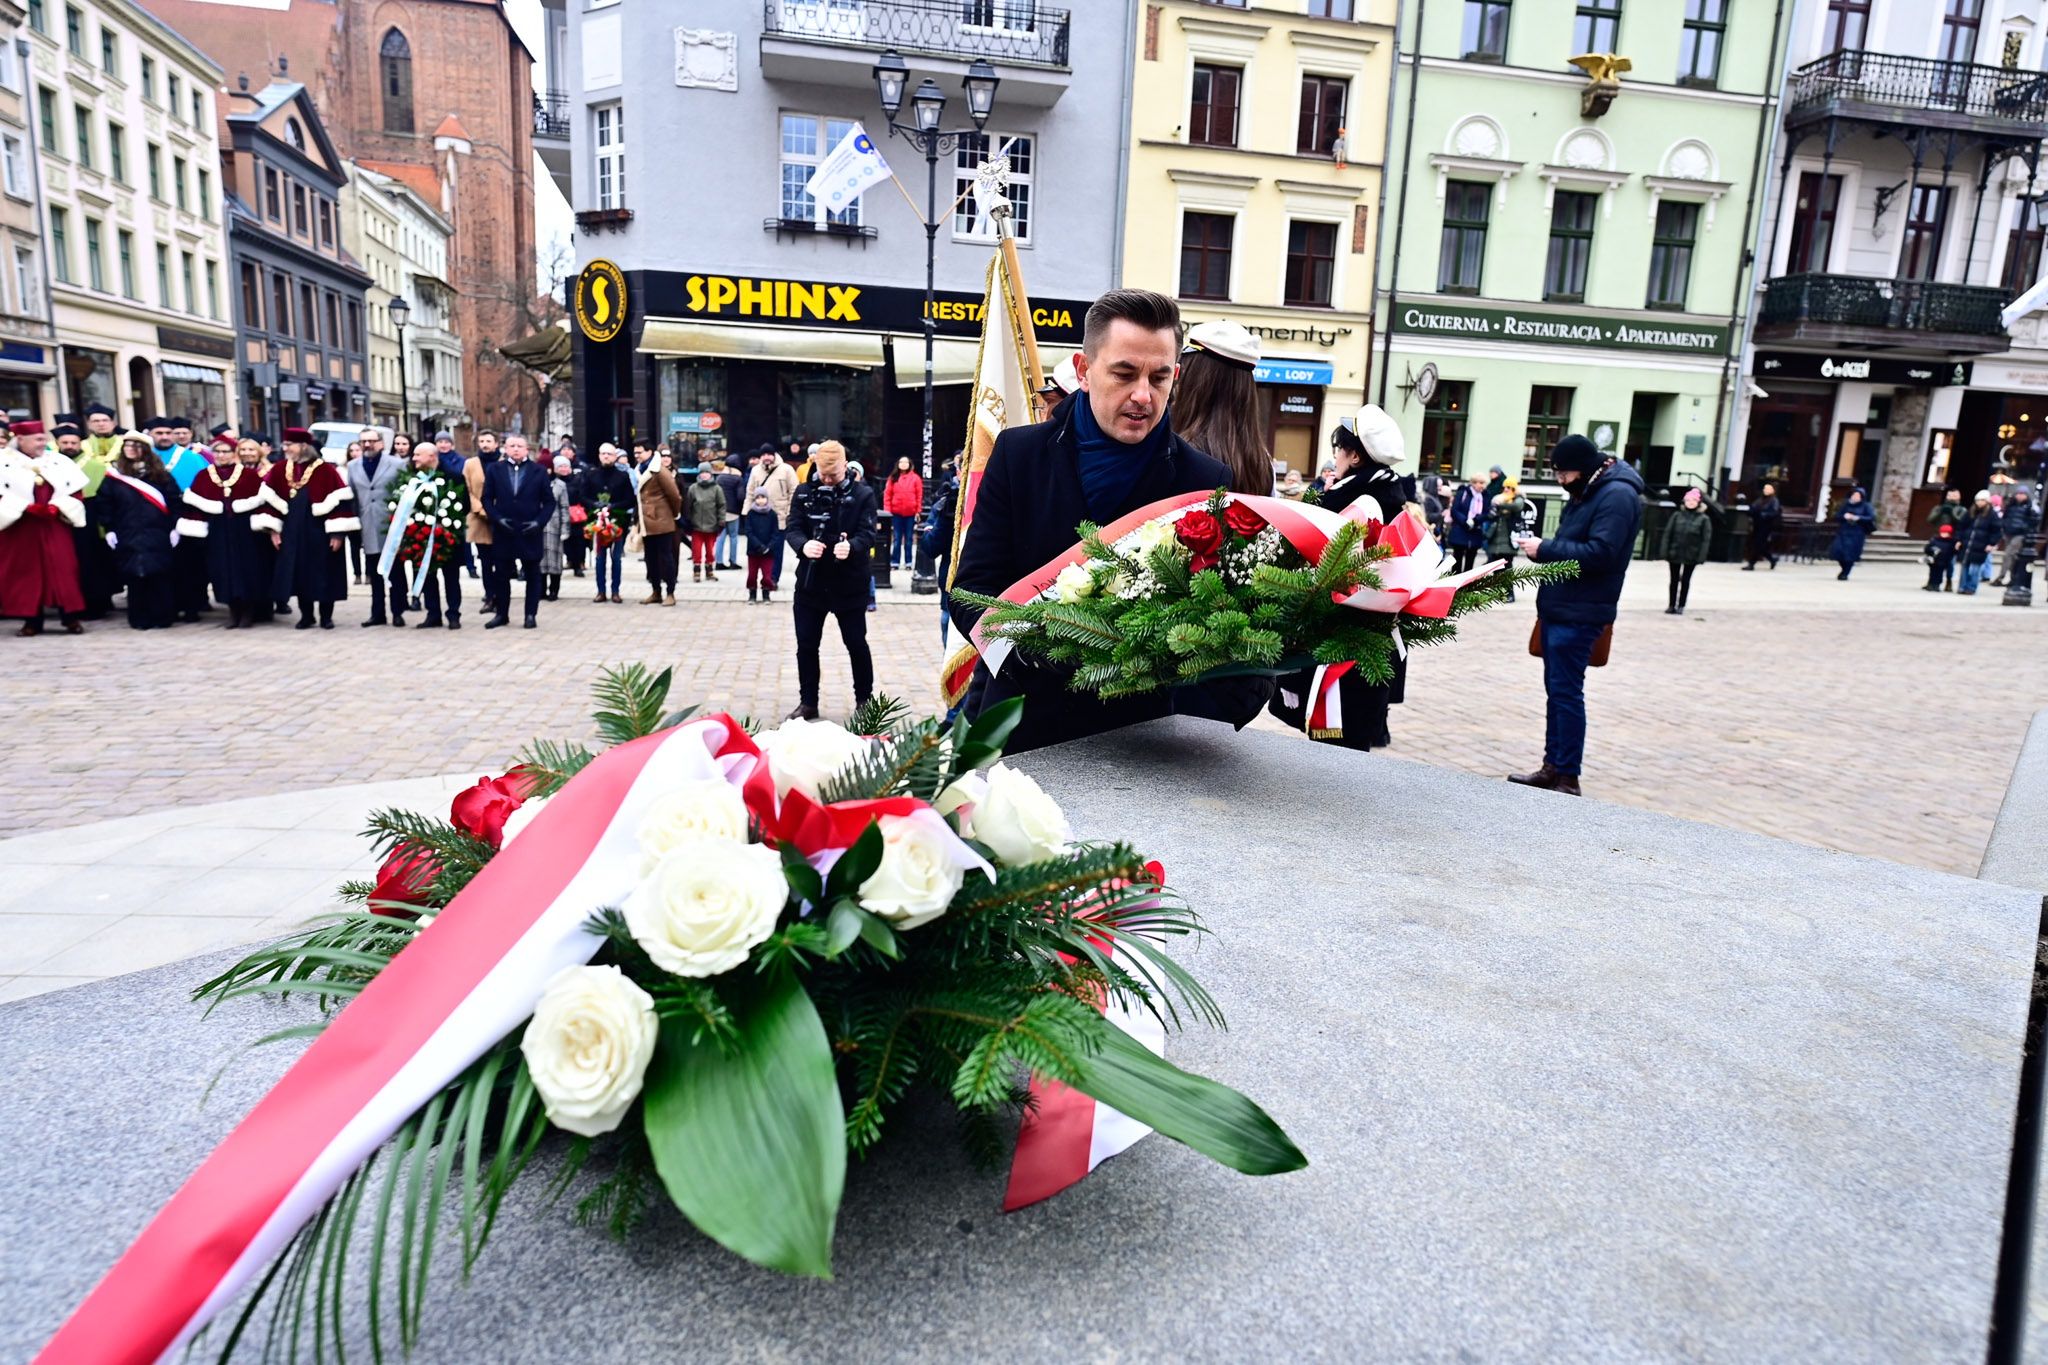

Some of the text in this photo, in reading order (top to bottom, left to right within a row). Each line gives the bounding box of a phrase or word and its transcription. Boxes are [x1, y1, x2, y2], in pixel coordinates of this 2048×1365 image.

[592, 276, 610, 324] S
[686, 276, 861, 321] SPHINX
[924, 301, 1073, 327] RESTACJA
[1404, 309, 1719, 348] CUKIERNIA RESTAURACJA APARTAMENTY
[1285, 370, 1315, 381] LODY
[1288, 396, 1307, 404] LODY
